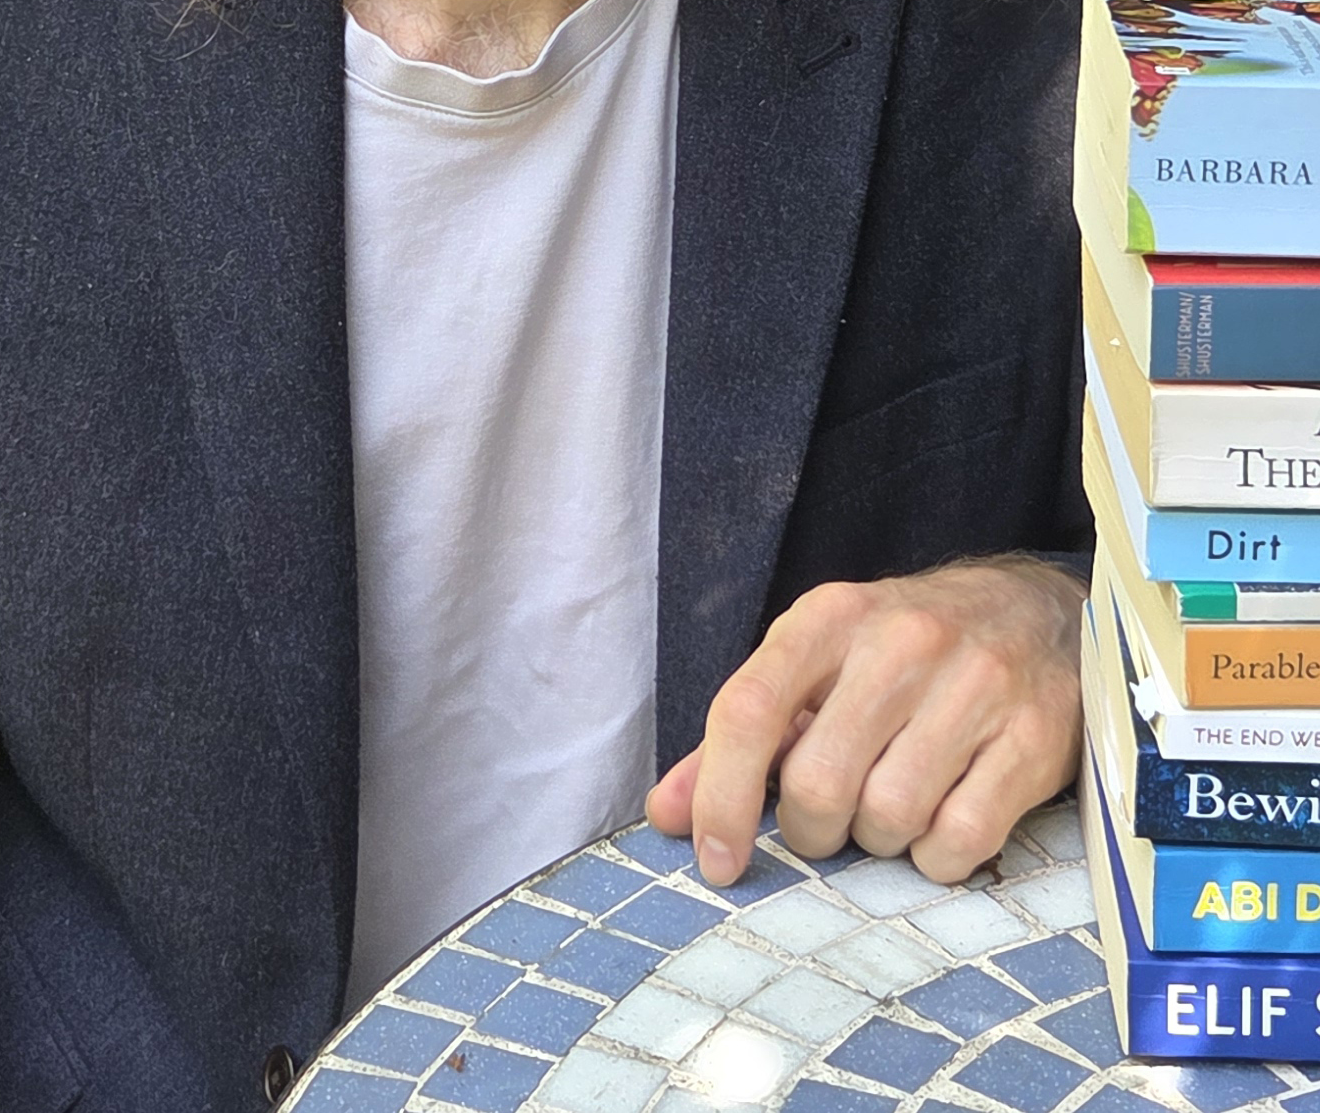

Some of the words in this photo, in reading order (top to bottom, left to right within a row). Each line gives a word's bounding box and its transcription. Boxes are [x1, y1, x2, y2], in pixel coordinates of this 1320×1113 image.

[1155, 158, 1313, 186] BARBARA
[1196, 295, 1213, 375] SHUSTERMAN
[1207, 530, 1281, 561] Dirt
[1193, 727, 1232, 746] THE
[1240, 729, 1284, 747] END
[1192, 881, 1278, 921] ABI
[1166, 983, 1290, 1037] ELIF
